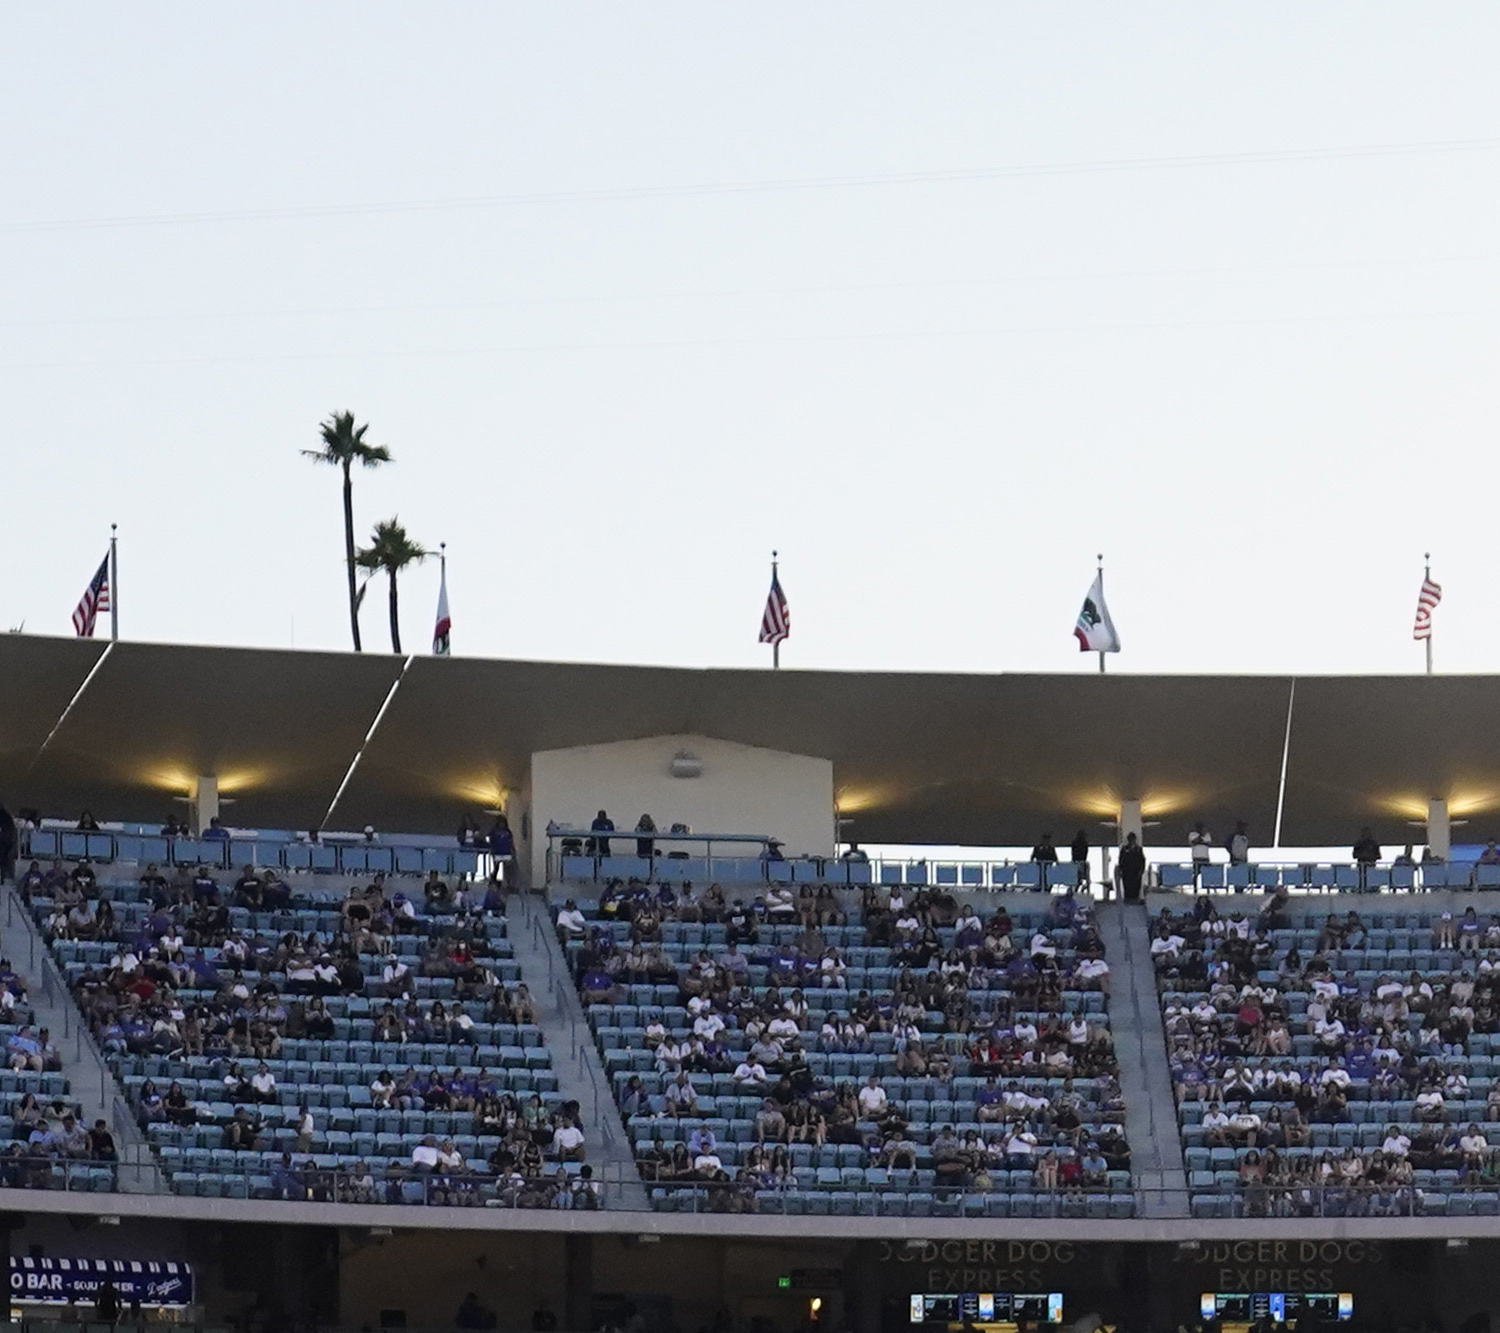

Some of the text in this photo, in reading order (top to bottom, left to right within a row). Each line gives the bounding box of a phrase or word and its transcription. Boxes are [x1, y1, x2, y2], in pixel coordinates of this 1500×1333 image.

[27, 1273, 63, 1290] BAR
[928, 1268, 1043, 1290] EXPRESS
[1220, 1268, 1333, 1290] EXPRESS
